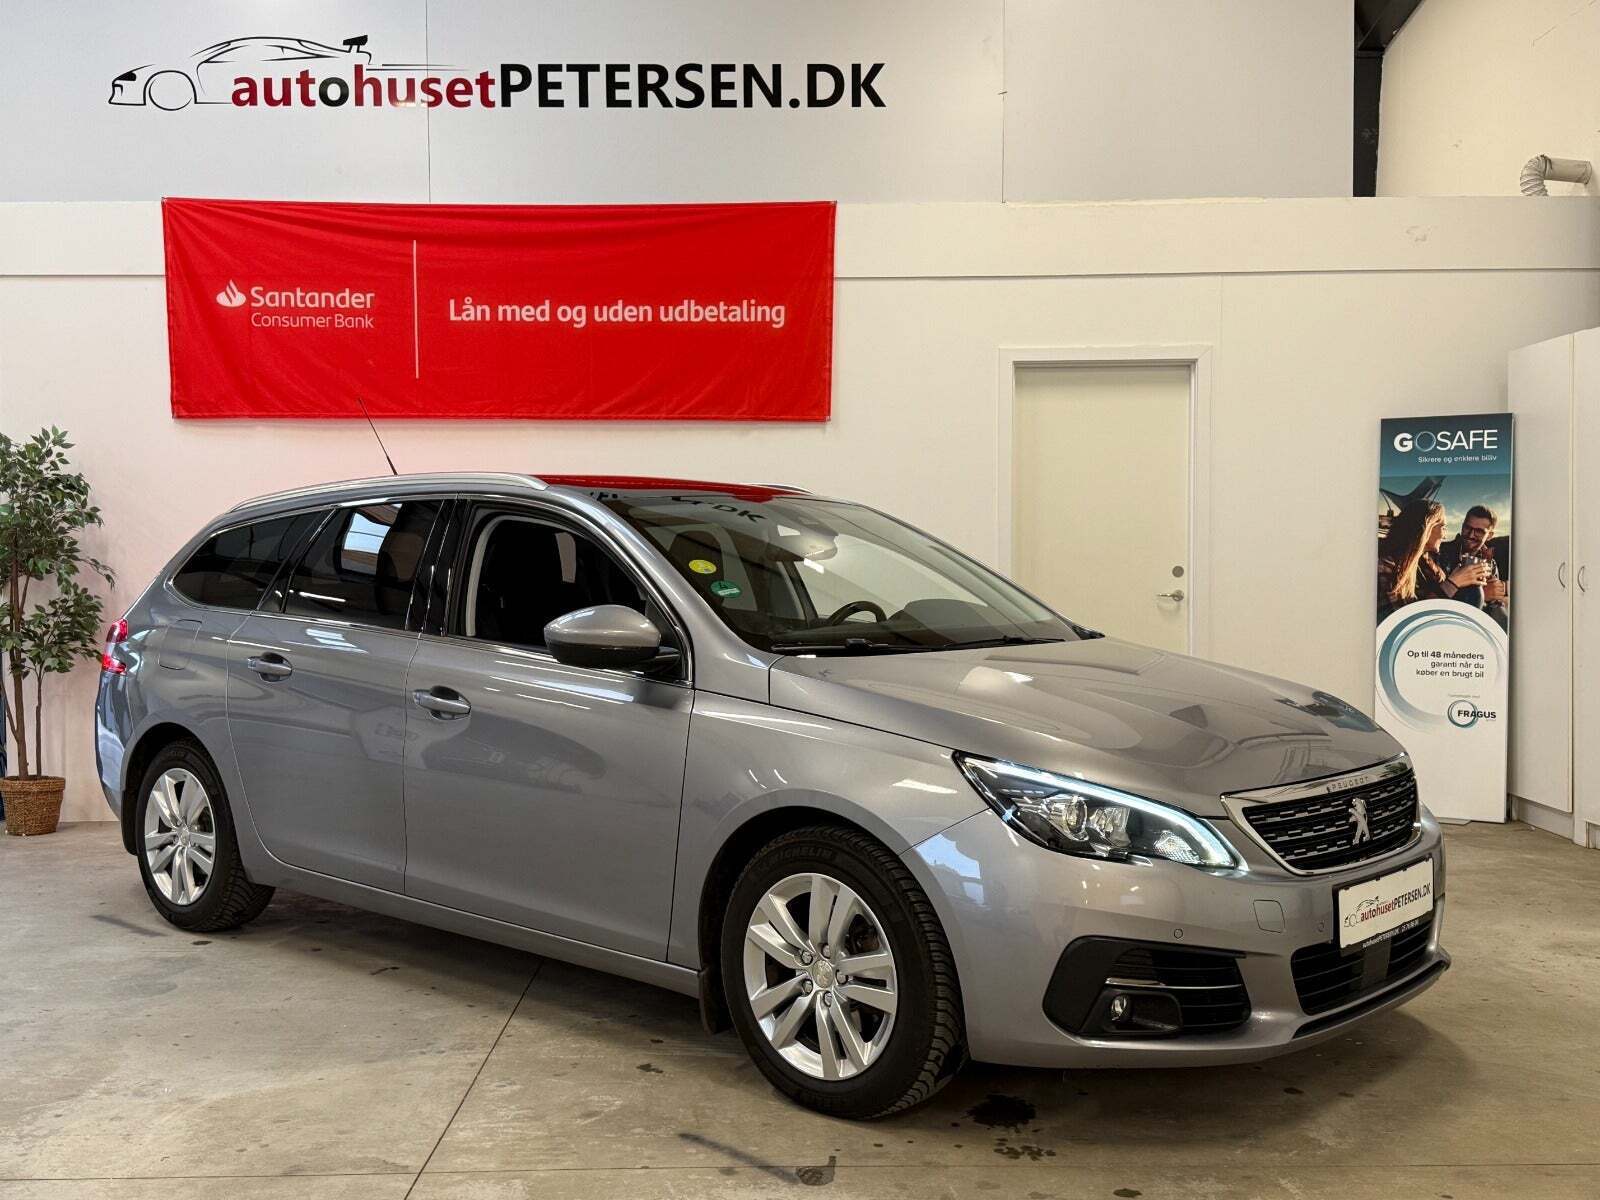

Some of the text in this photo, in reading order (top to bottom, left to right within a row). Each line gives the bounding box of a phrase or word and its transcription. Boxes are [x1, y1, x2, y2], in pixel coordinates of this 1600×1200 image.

[250, 286, 375, 309] Santander
[251, 312, 375, 328] Consumer Bank
[449, 297, 786, 329] Lån med og uden udbetaling
[1393, 429, 1498, 453] GOSAFE
[1407, 650, 1420, 659] Op
[1421, 650, 1429, 658] til
[1443, 651, 1485, 660] måneders
[1430, 661, 1457, 669] garanti
[1459, 661, 1472, 669] når
[1452, 670, 1473, 679] brugt
[1457, 709, 1497, 719] FRAGUS
[1331, 776, 1369, 790] PEUGEOT
